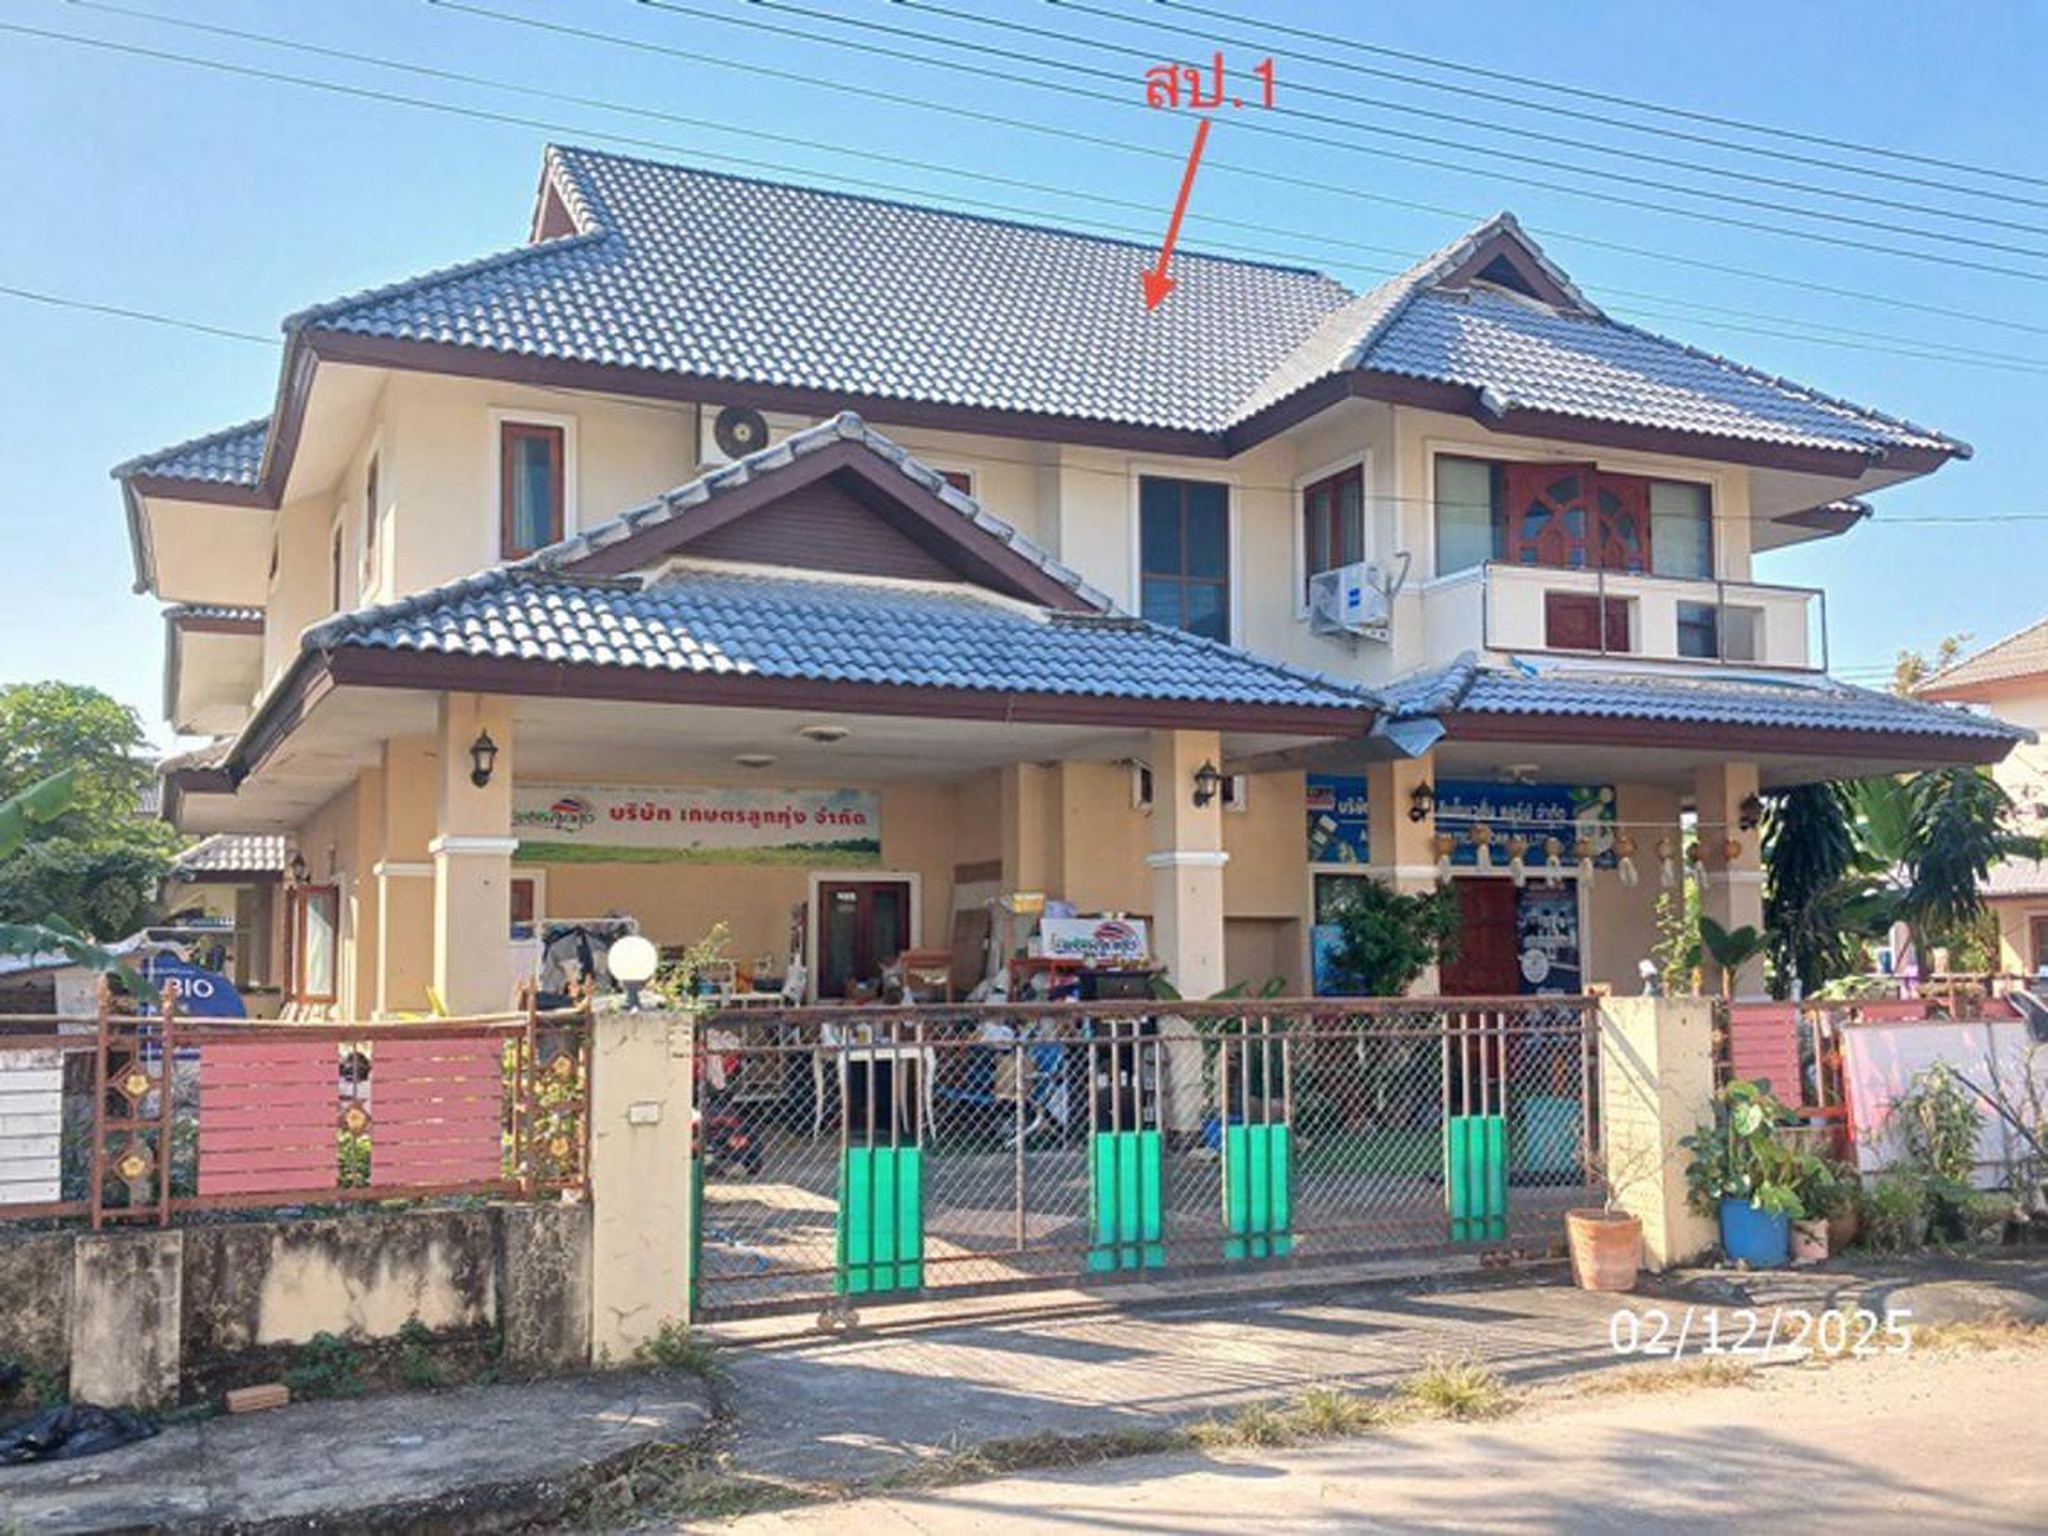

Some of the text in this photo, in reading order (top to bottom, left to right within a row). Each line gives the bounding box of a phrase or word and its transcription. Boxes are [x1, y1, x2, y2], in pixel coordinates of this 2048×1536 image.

[609, 802, 672, 822] บริษัท
[814, 806, 867, 826] จำกัด
